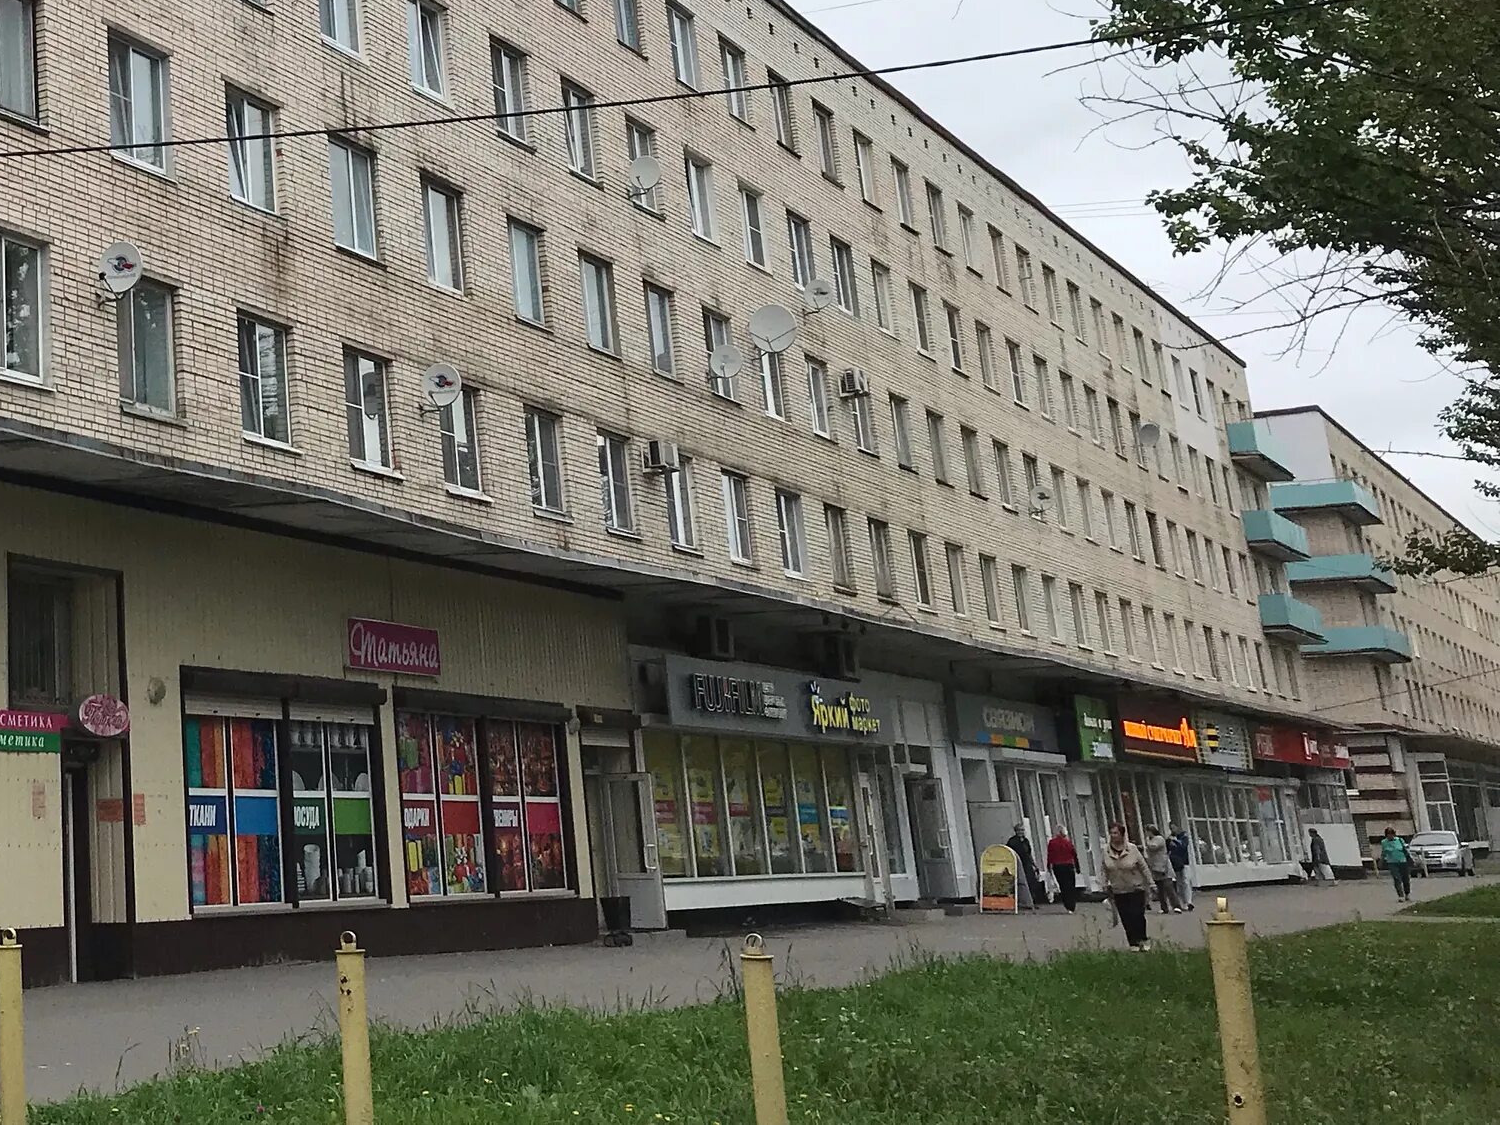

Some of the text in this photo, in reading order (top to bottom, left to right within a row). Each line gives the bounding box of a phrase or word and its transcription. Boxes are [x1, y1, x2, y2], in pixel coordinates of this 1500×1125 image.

[350, 622, 439, 668] Татьяна
[693, 672, 764, 716] FUJIFILM
[189, 804, 217, 827] ТКАНИ
[404, 807, 430, 829] ОДАРКИ
